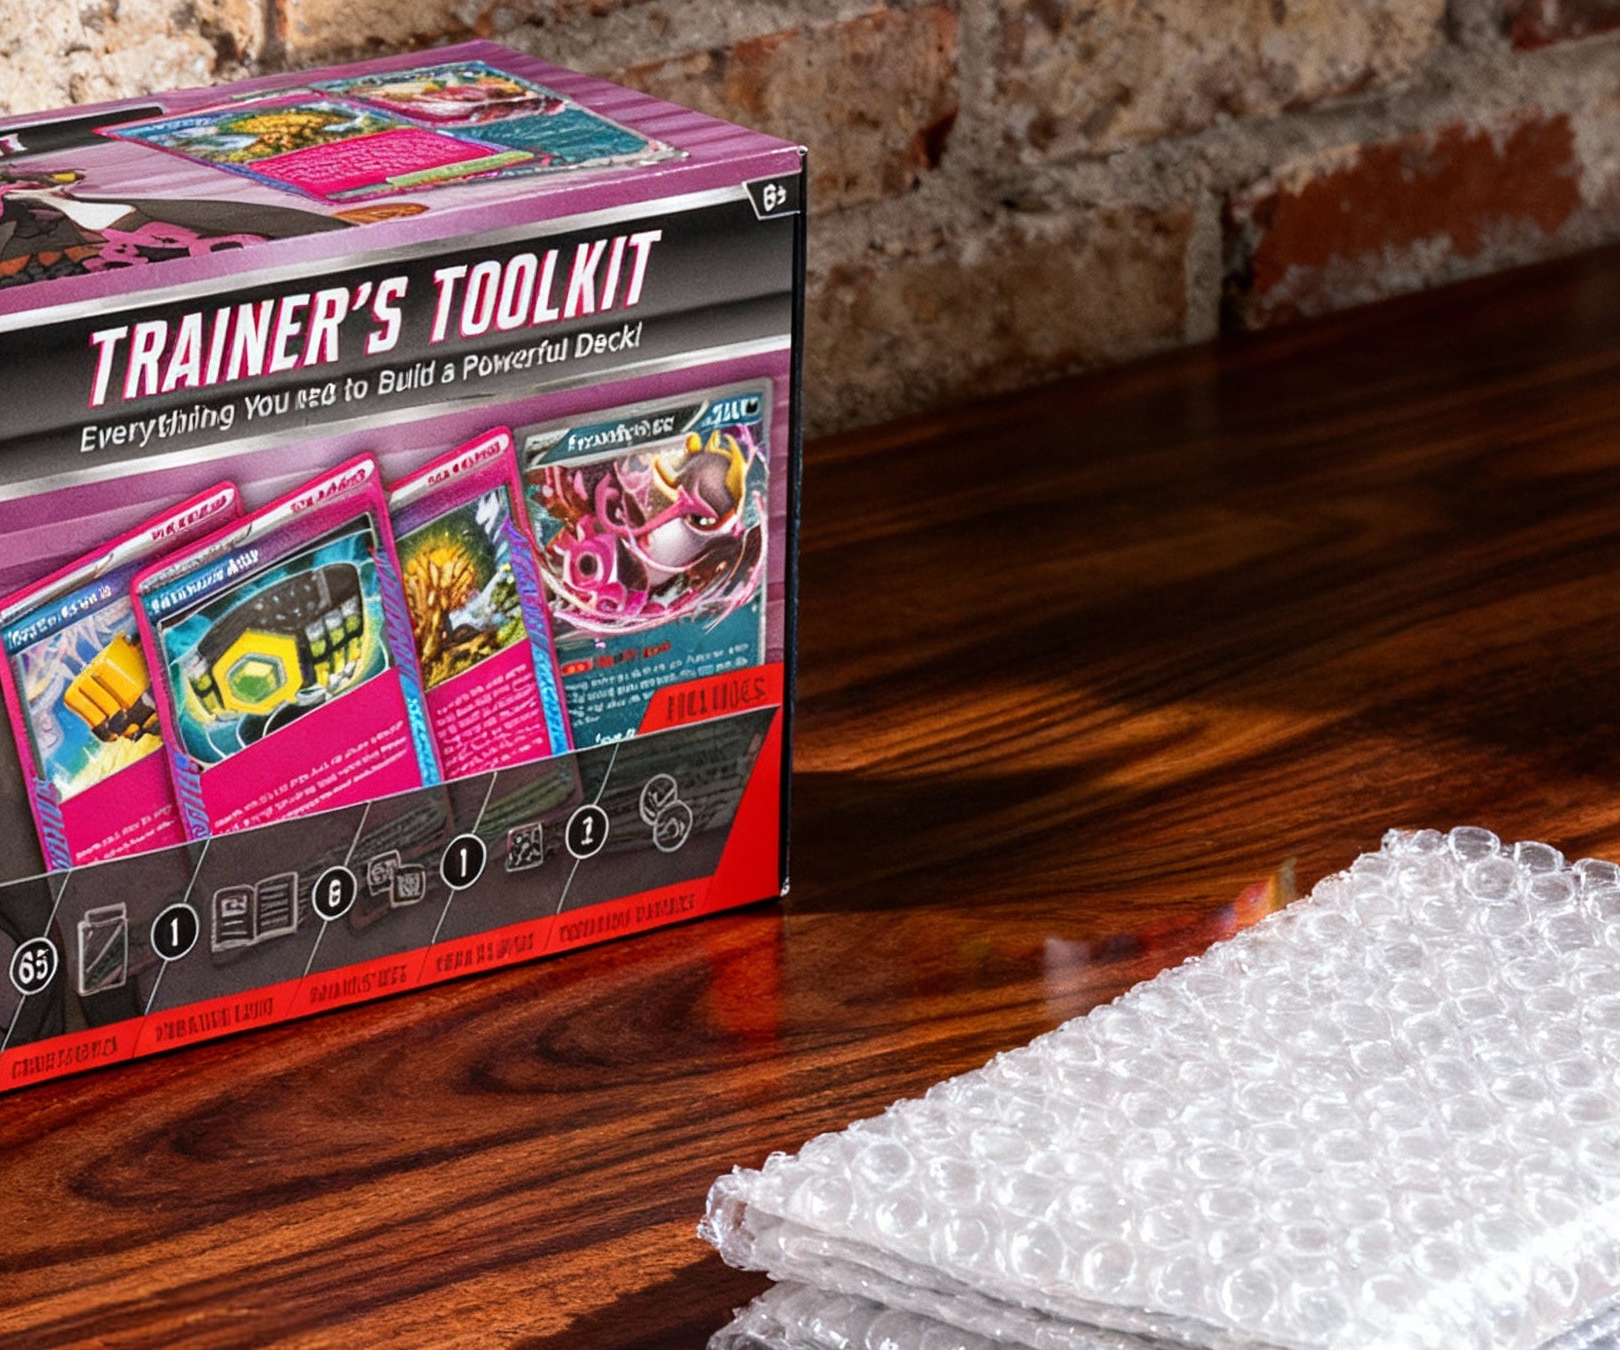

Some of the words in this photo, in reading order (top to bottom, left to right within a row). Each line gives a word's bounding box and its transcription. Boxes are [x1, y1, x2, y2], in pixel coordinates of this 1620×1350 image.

[88, 275, 409, 410] TRAINER'S
[430, 229, 663, 345] TOOLKIT
[343, 377, 369, 403] to
[377, 358, 437, 396] Build
[441, 363, 456, 384] a
[463, 336, 568, 381] Powerful
[460, 847, 468, 878] 1
[170, 917, 179, 947] 1
